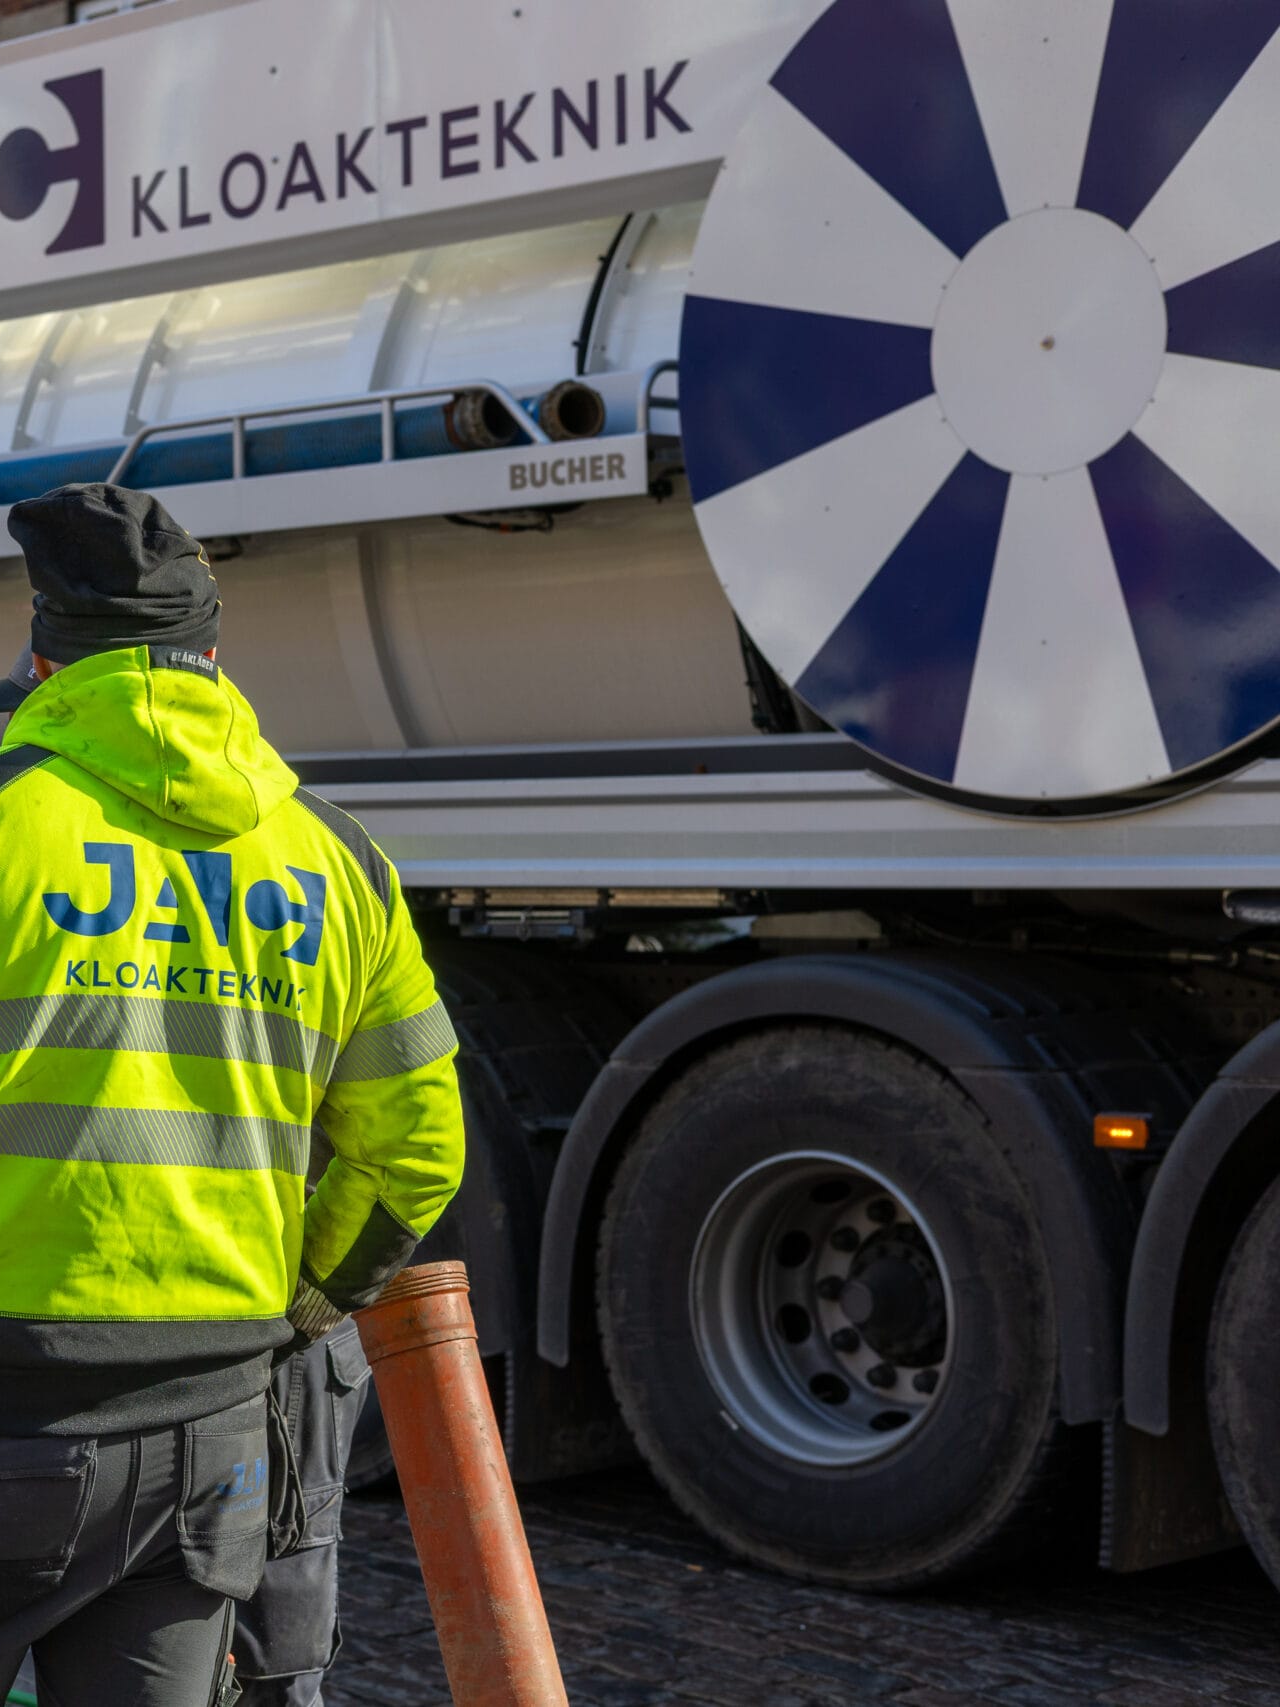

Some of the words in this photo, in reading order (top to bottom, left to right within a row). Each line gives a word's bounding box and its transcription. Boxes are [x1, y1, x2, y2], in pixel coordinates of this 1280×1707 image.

[131, 59, 694, 238] KLOAKTEKNIK
[509, 453, 626, 491] BUCHER
[171, 651, 214, 672] BLÅKLÄDER
[42, 841, 327, 967] JAC
